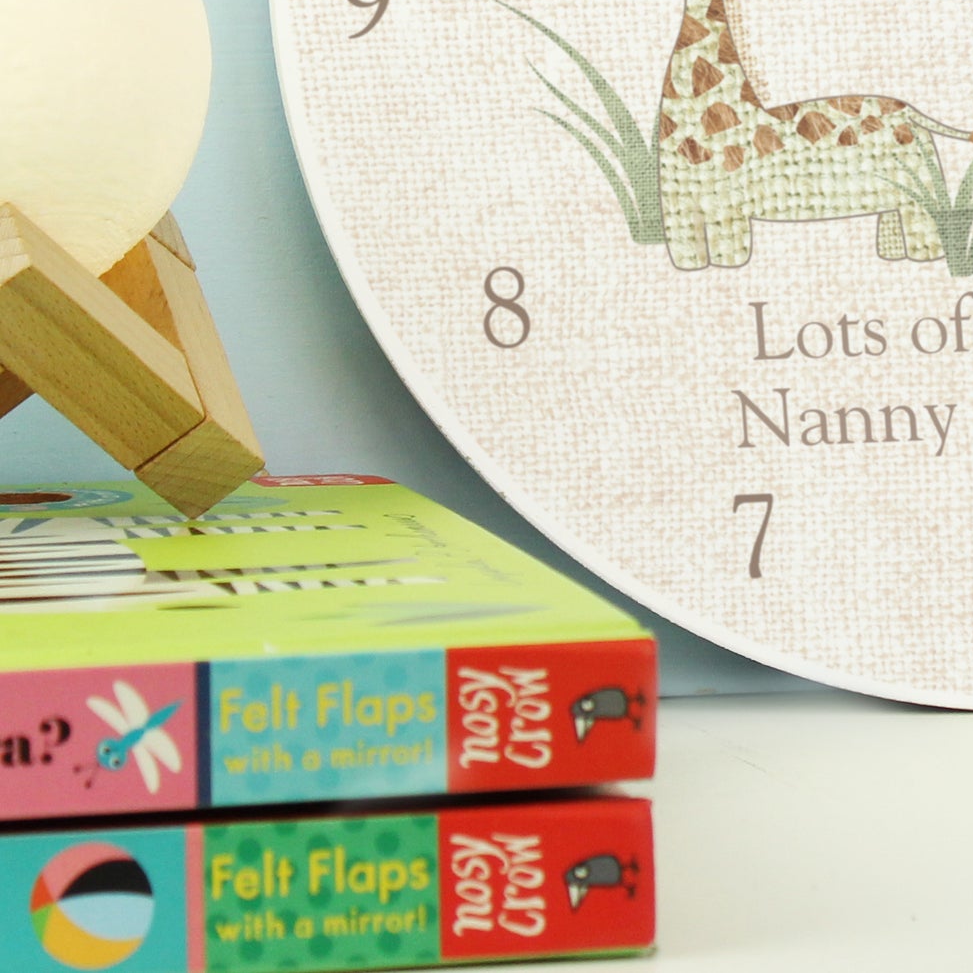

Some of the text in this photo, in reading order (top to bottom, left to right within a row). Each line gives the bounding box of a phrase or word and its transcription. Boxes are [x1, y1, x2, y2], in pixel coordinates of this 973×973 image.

[482, 265, 532, 350] 8
[748, 297, 888, 361] Lots
[731, 387, 958, 458] Nanny
[731, 492, 775, 580] 7
[219, 676, 437, 737] Felt Flaps
[457, 666, 516, 769] nosy
[223, 737, 434, 774] with a mirror!
[210, 844, 430, 904] Felt Flaps
[449, 833, 509, 937] nosy
[215, 903, 427, 942] with a mirror!
